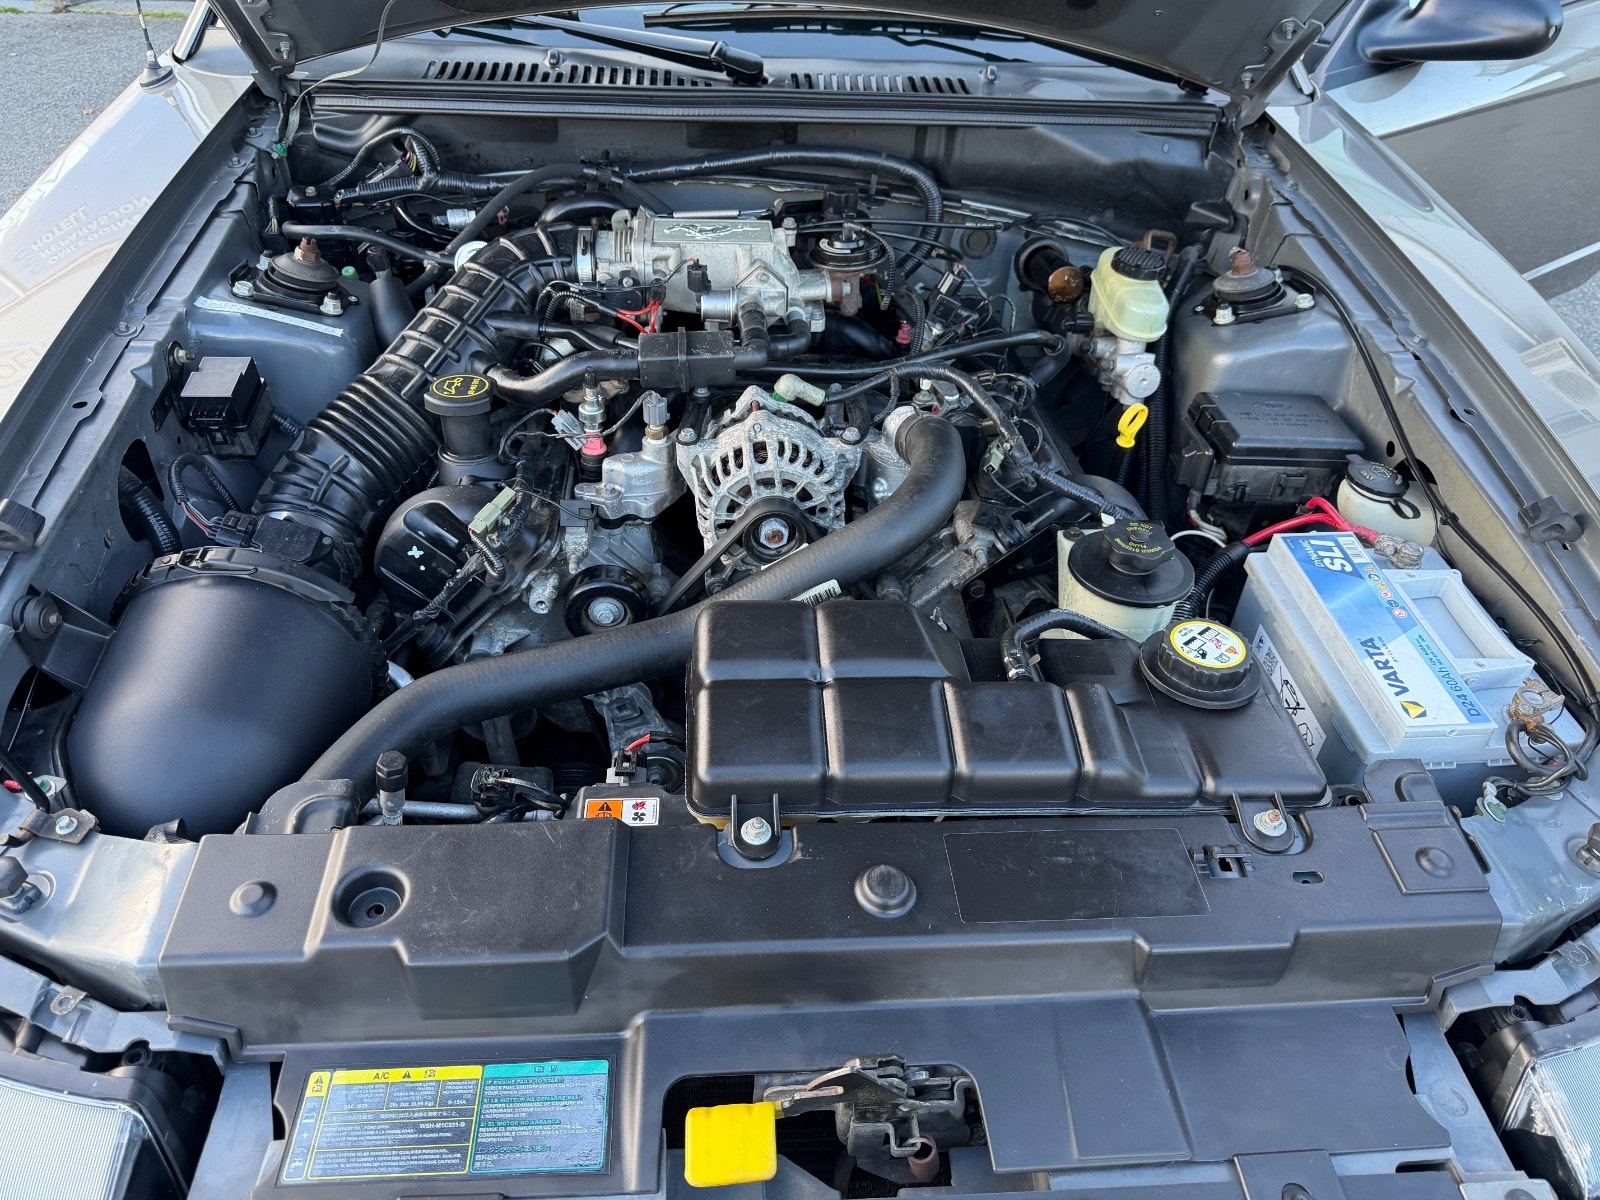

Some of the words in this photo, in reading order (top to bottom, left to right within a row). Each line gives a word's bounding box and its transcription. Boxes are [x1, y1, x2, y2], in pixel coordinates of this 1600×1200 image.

[1299, 539, 1324, 568] DYNAMIC
[1308, 539, 1353, 573] SLI
[1360, 637, 1410, 697] VARTA
[1437, 665, 1465, 694] 60Ah
[1456, 691, 1482, 718] D24
[373, 1072, 390, 1080] A/C
